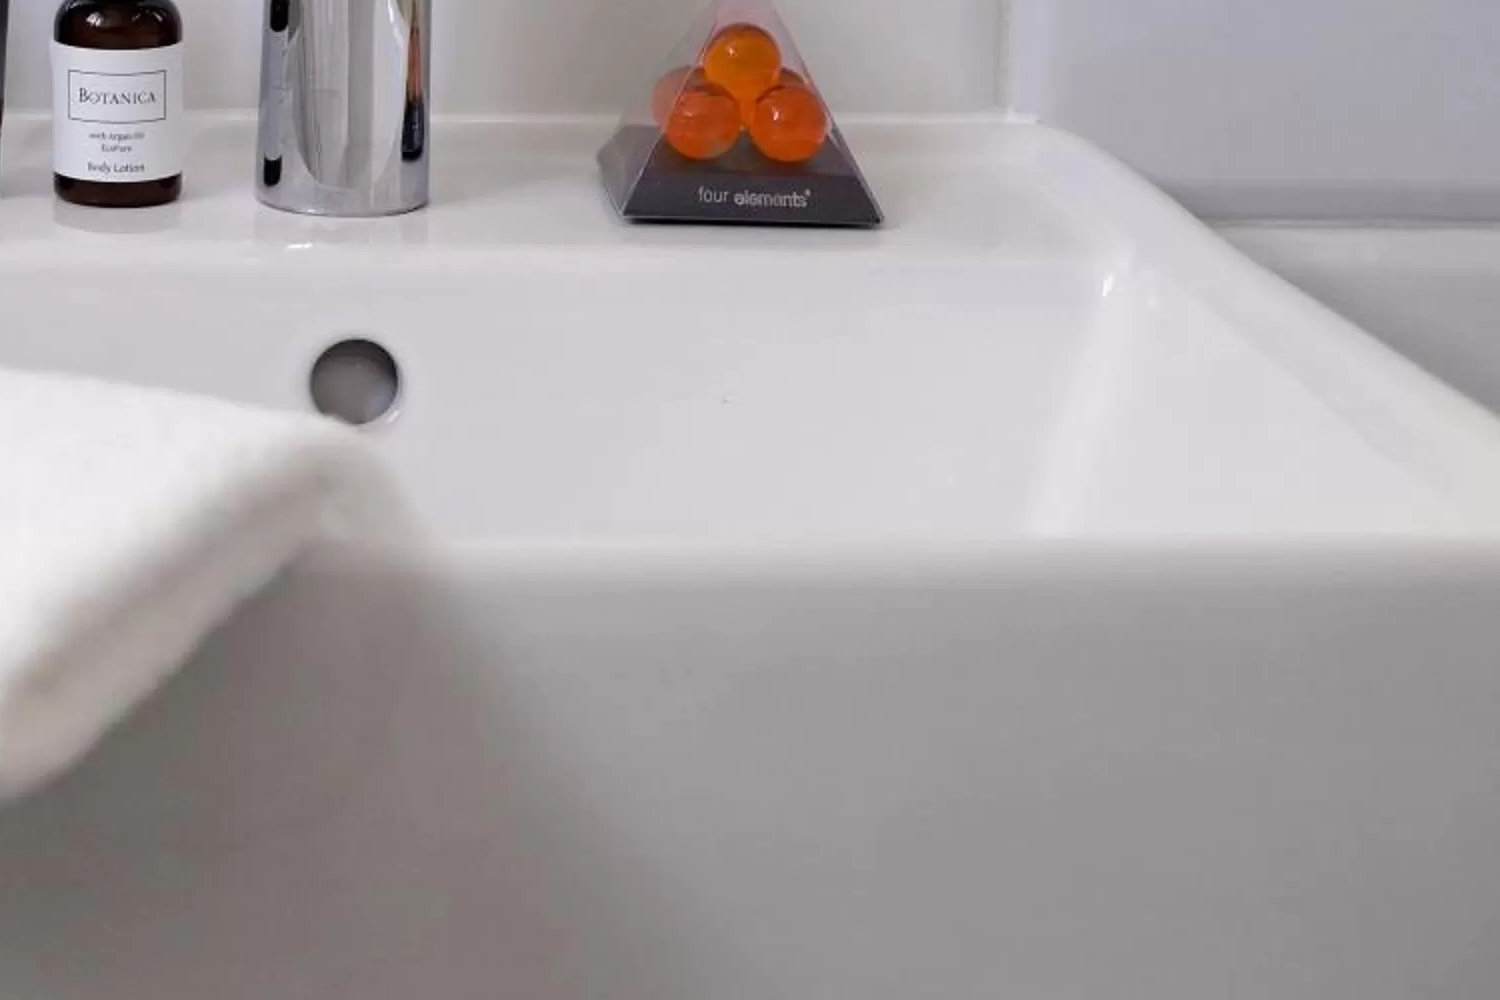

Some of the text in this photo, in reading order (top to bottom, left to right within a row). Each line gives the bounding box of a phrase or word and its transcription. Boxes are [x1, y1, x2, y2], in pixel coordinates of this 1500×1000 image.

[87, 161, 145, 173] Body Lotion
[698, 185, 729, 203] four
